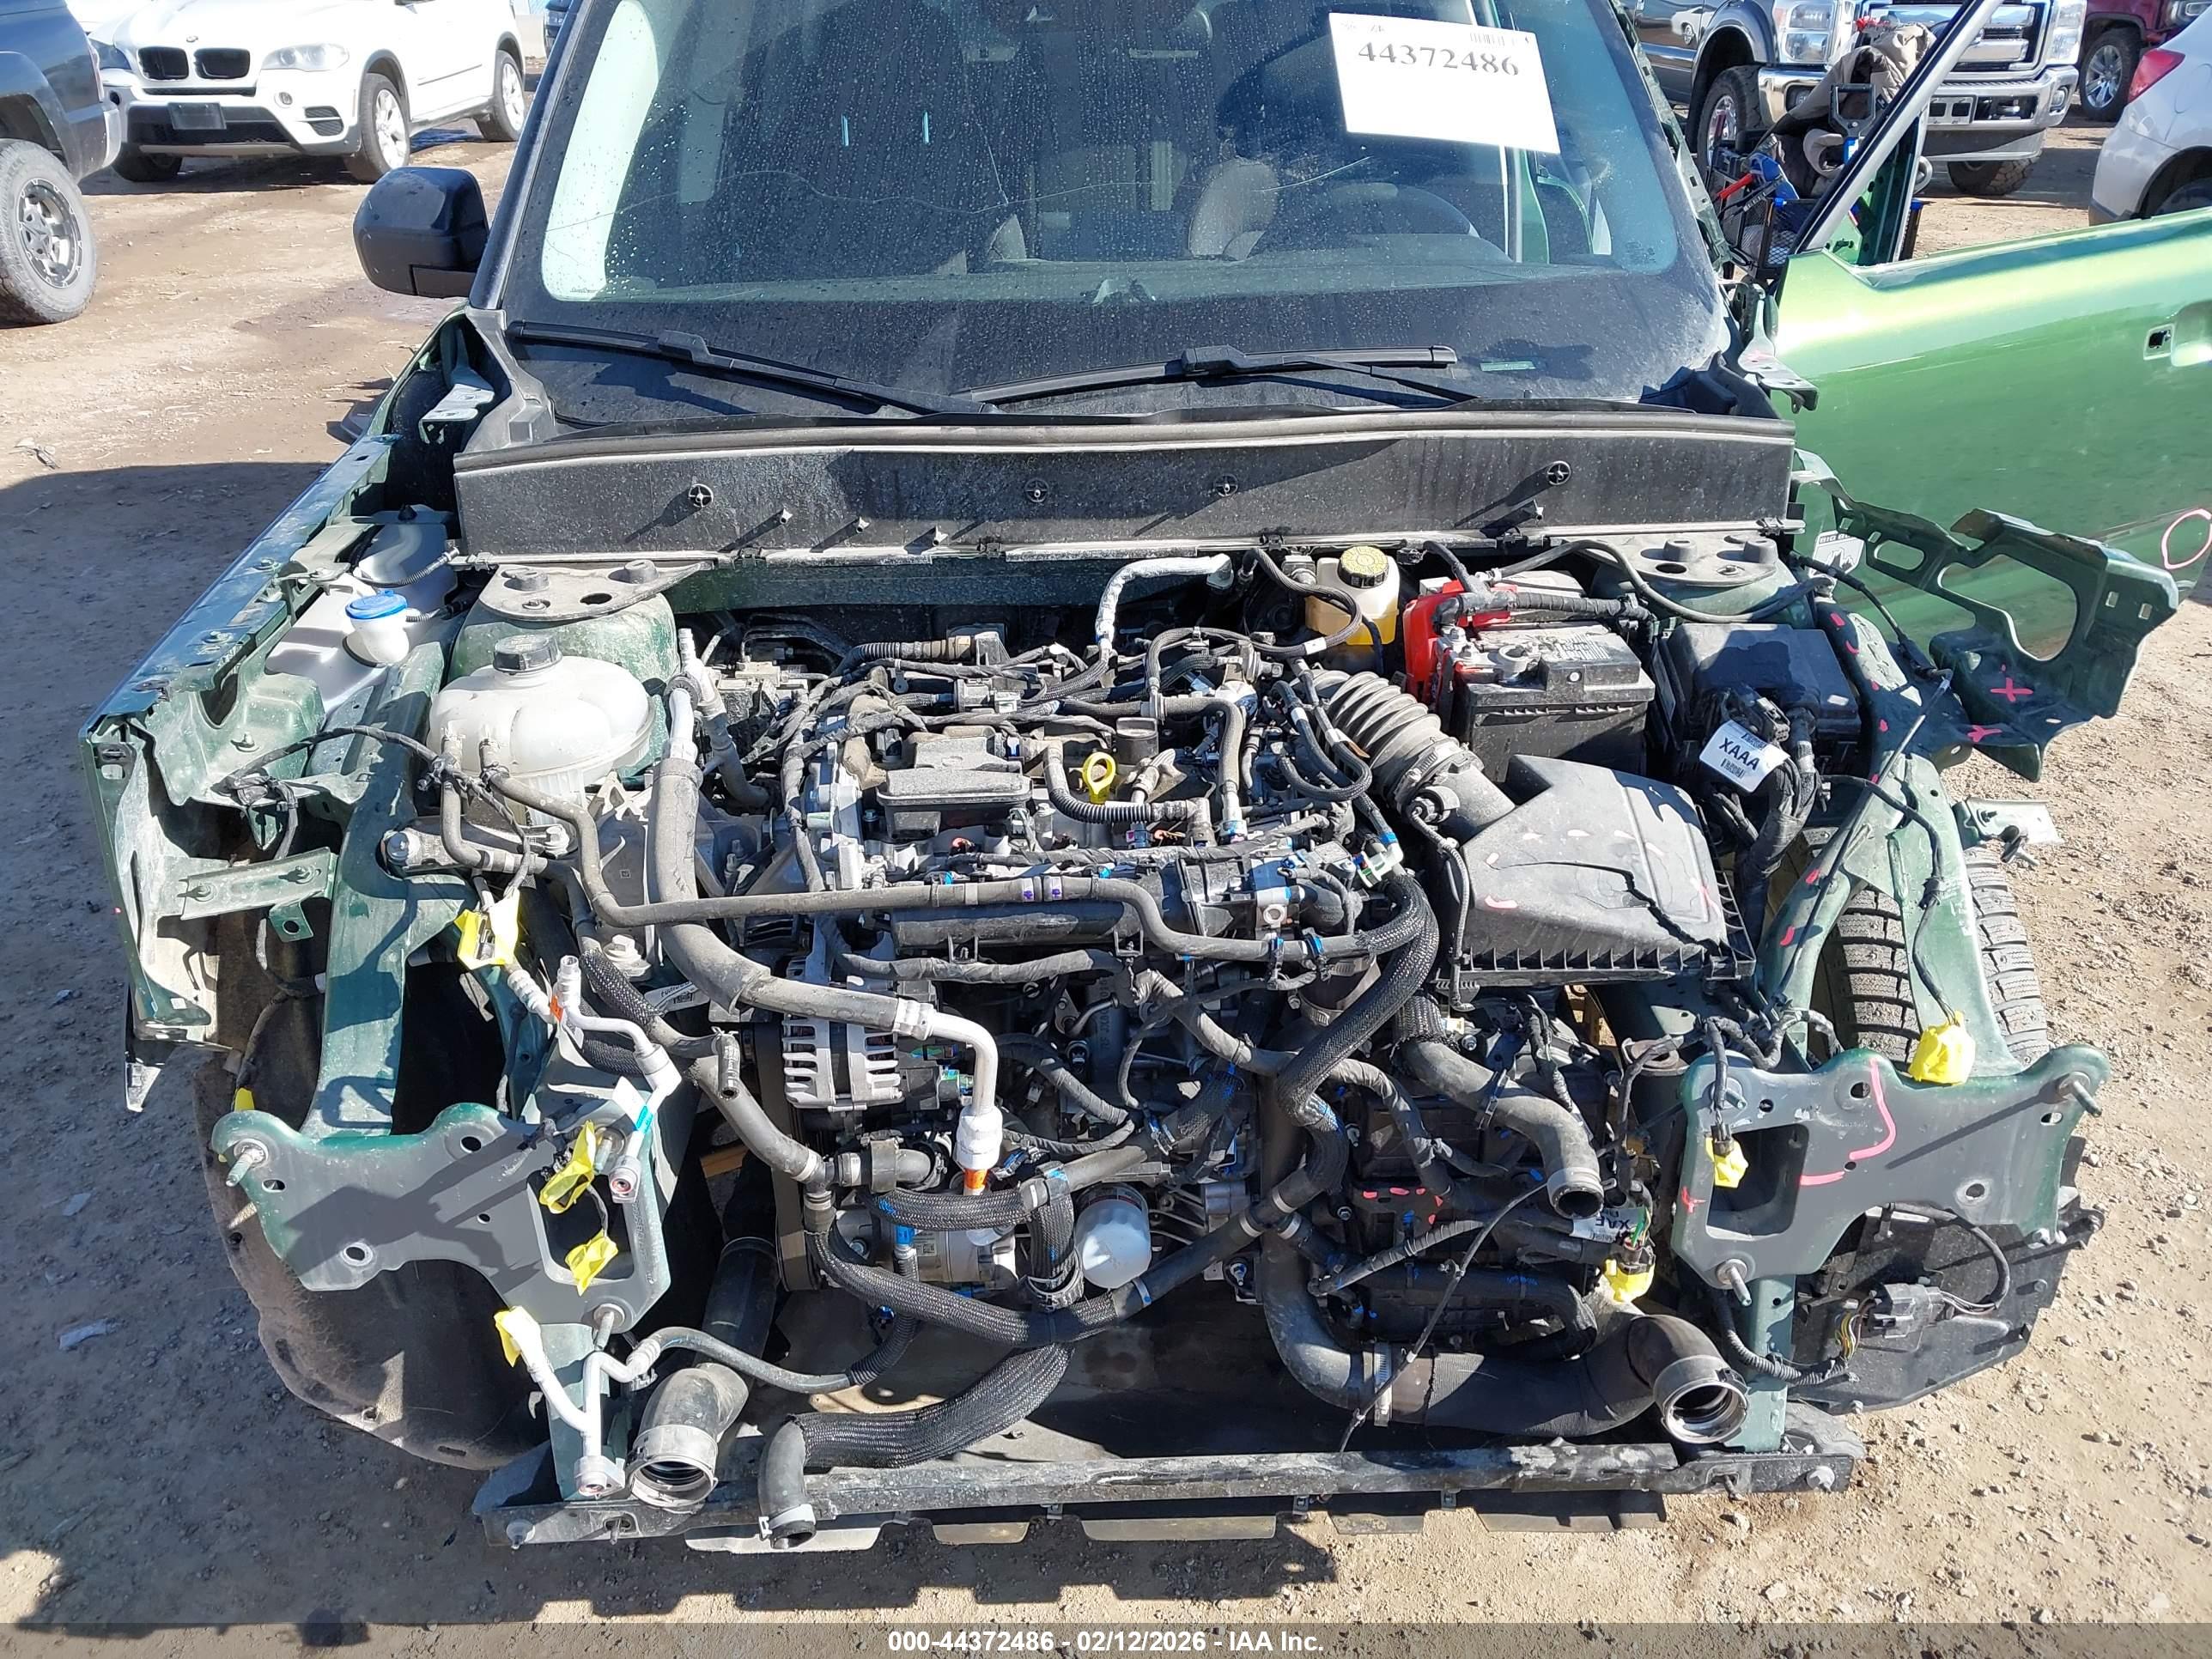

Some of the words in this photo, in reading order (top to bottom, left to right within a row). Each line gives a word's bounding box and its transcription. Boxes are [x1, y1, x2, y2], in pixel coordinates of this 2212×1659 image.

[1358, 41, 1519, 76] 44372486
[1820, 535, 1837, 544] BIG
[1719, 737, 1760, 771] XAAA
